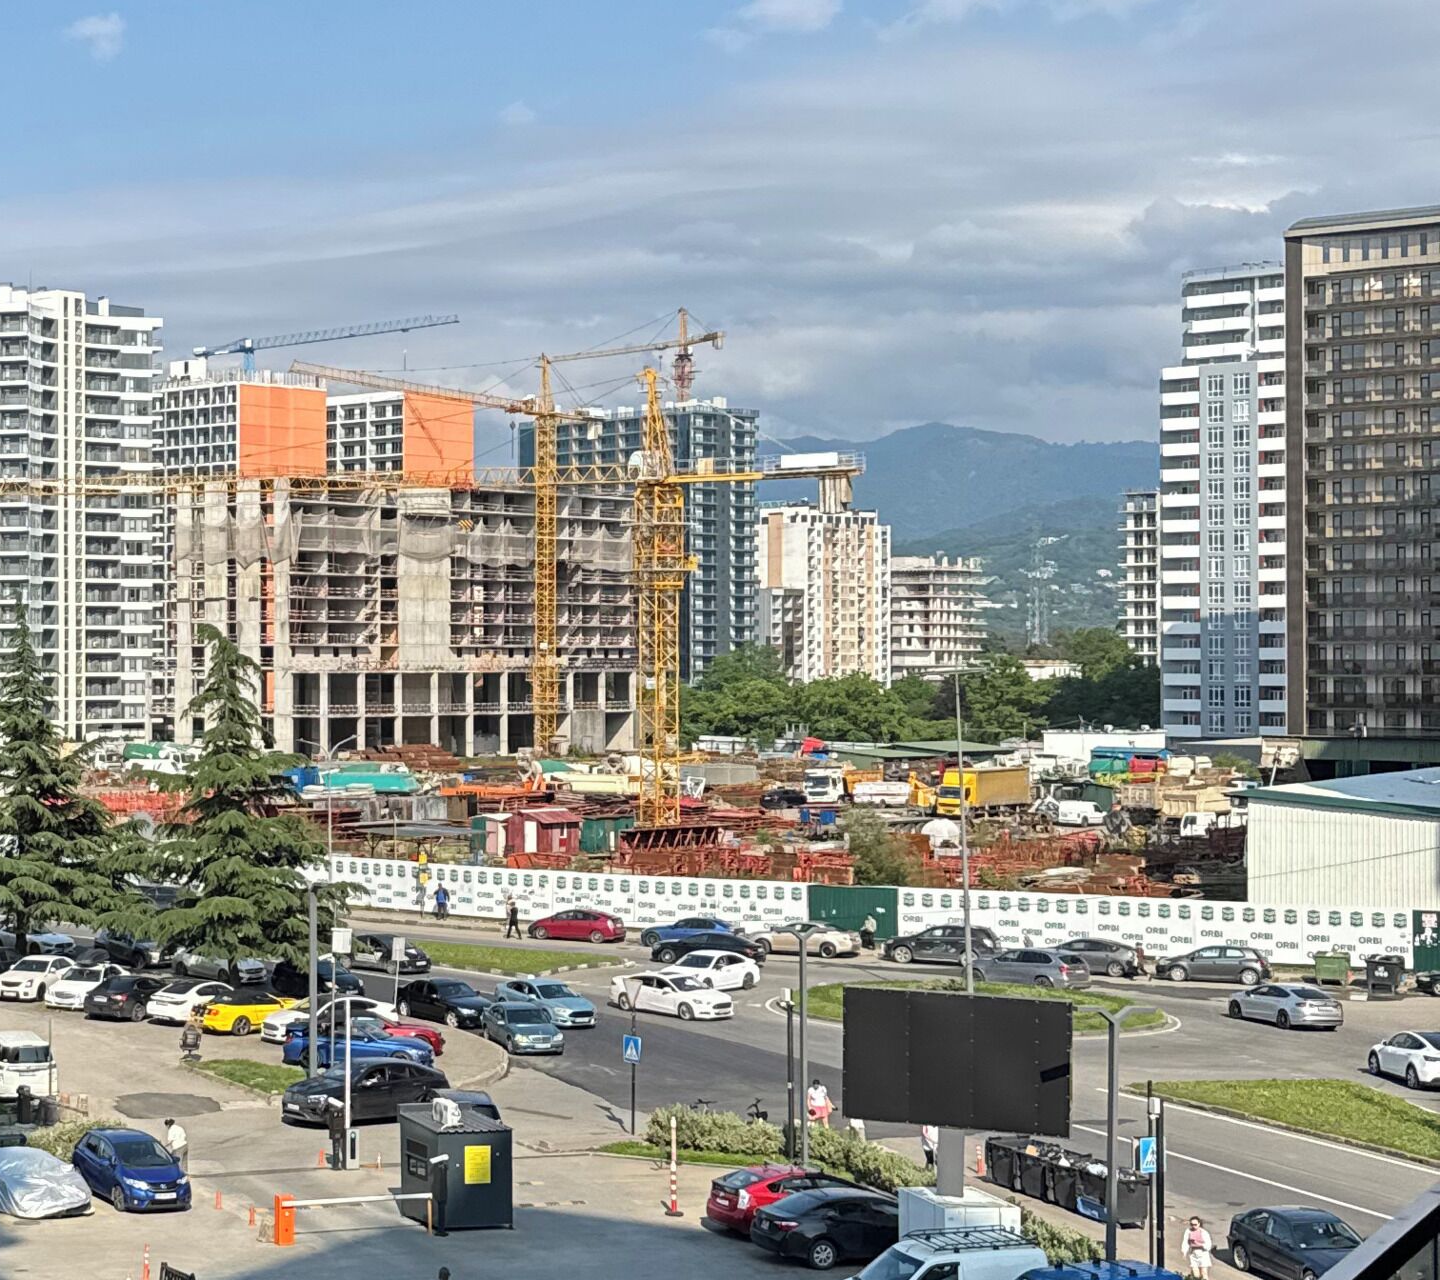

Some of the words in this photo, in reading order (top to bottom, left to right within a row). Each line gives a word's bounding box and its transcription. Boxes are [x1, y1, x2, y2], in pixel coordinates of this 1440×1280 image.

[1250, 932, 1273, 940] ORBI
[1307, 934, 1330, 943] ORBI
[1359, 936, 1382, 945] ORBI
[1275, 941, 1299, 950] ORBI
[1385, 945, 1409, 954] ORBI
